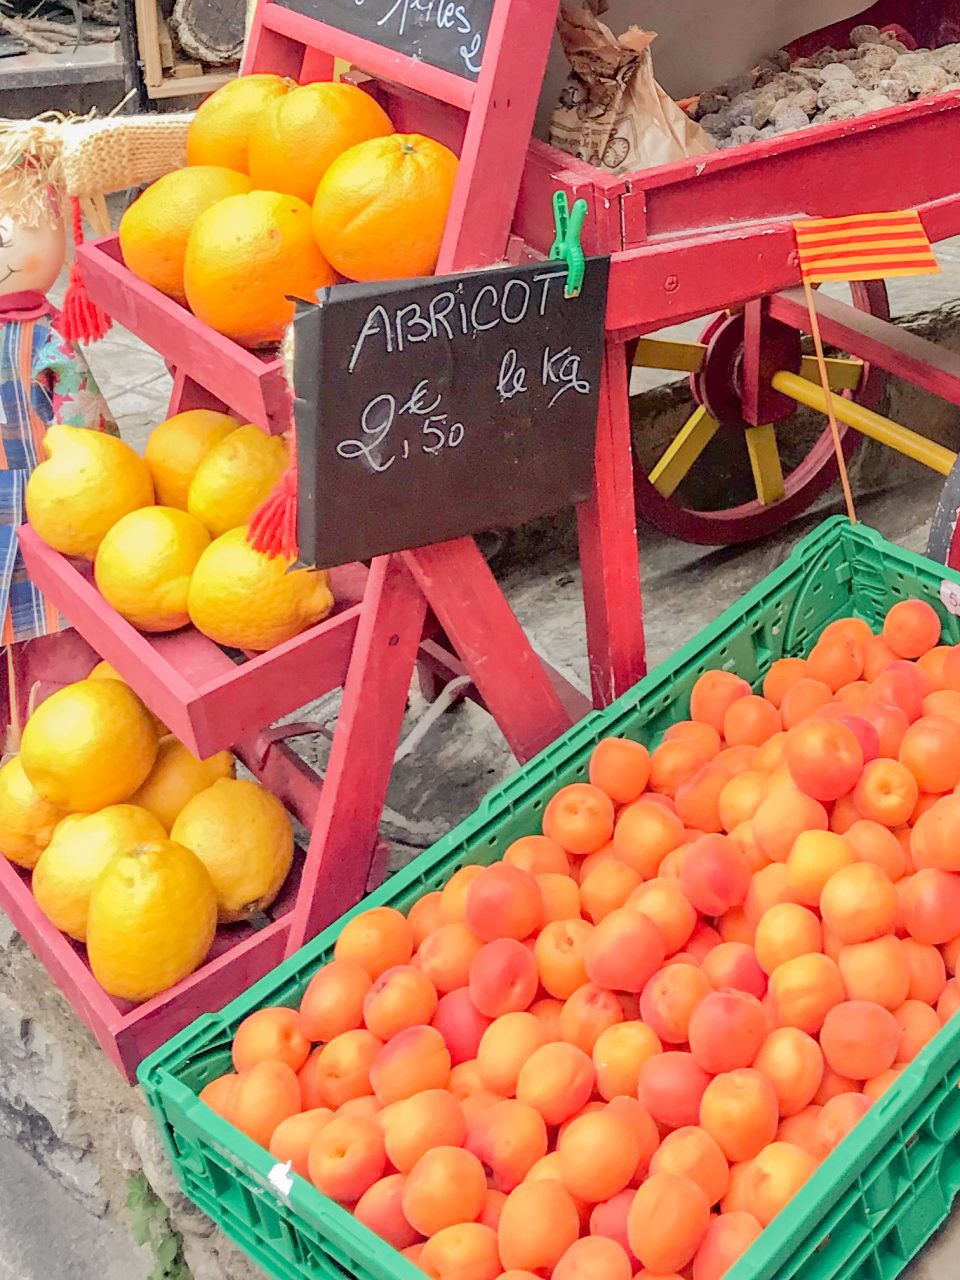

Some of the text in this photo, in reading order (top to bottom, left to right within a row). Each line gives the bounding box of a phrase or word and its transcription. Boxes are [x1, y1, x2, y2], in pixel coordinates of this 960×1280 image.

[460, 33, 482, 72] 2
[349, 270, 569, 373] ABRICOT
[496, 349, 527, 401] le
